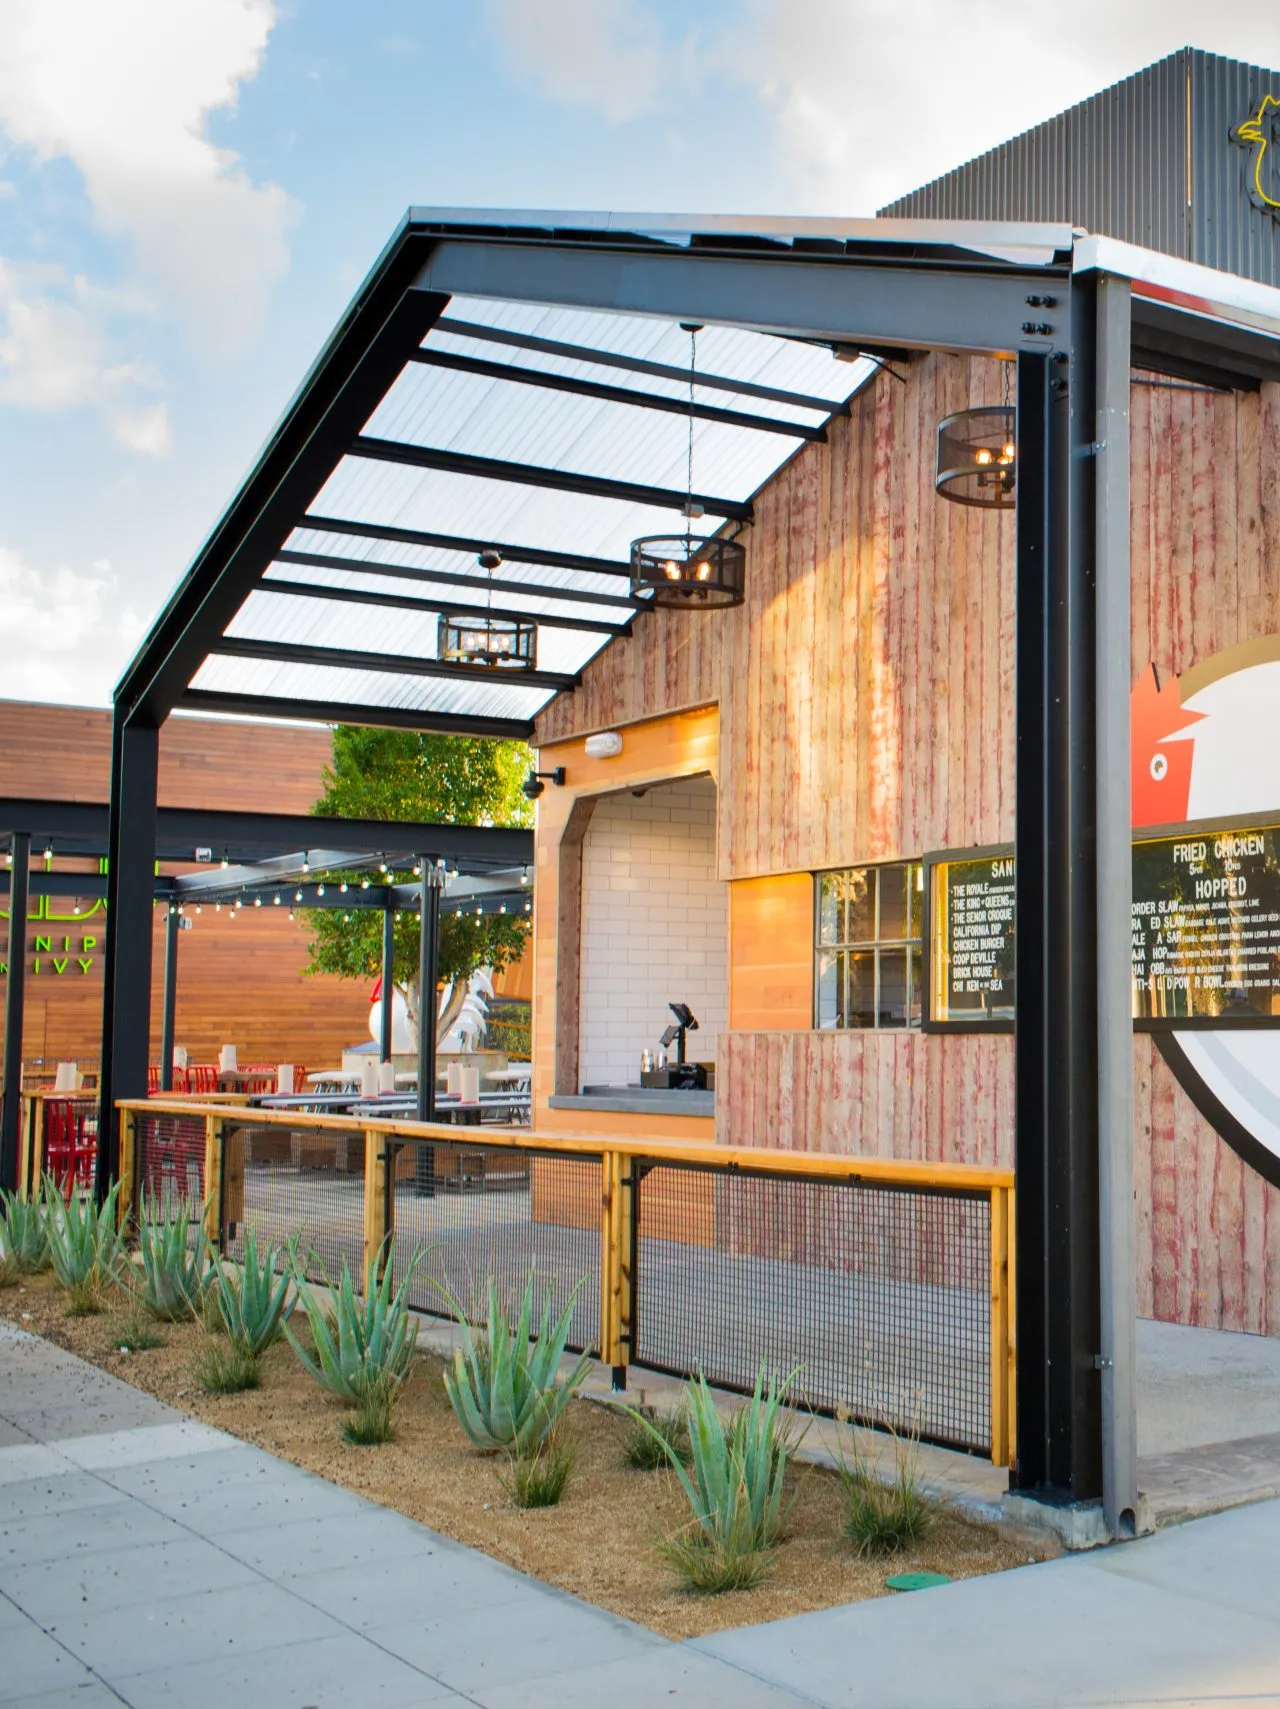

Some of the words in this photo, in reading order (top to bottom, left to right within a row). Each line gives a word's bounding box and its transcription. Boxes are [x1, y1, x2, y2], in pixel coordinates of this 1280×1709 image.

[1173, 842, 1206, 863] FRIED
[1214, 836, 1265, 859] CHICKEN
[953, 885, 966, 898] THE
[966, 883, 989, 896] ROYALE
[1195, 876, 1247, 899] HOPPED
[953, 898, 966, 911] THE
[966, 897, 980, 910] KING
[985, 895, 1010, 908] QUEENS
[1131, 902, 1156, 915] ORDER
[1158, 900, 1179, 913] SLAW
[953, 911, 966, 924] THE
[966, 910, 987, 923] SENOR
[988, 908, 1012, 921] CROQUE
[1164, 915, 1186, 929] SLAW
[953, 924, 990, 938] CALIFORNIA
[991, 922, 1002, 935] DIP
[36, 935, 97, 952] NIP
[953, 938, 979, 951] CHICKEN
[980, 936, 1005, 950] BURGER
[1131, 932, 1146, 946] ALE
[953, 953, 969, 966] COOP
[970, 951, 996, 965] DEVILLE
[1131, 948, 1146, 961] AJA
[34, 957, 94, 974] IVY
[953, 966, 972, 979] BRICK
[972, 965, 993, 978] HOUSE
[1131, 962, 1145, 976] HAI
[990, 978, 1003, 991] SEA
[1203, 974, 1225, 988] BOWL
